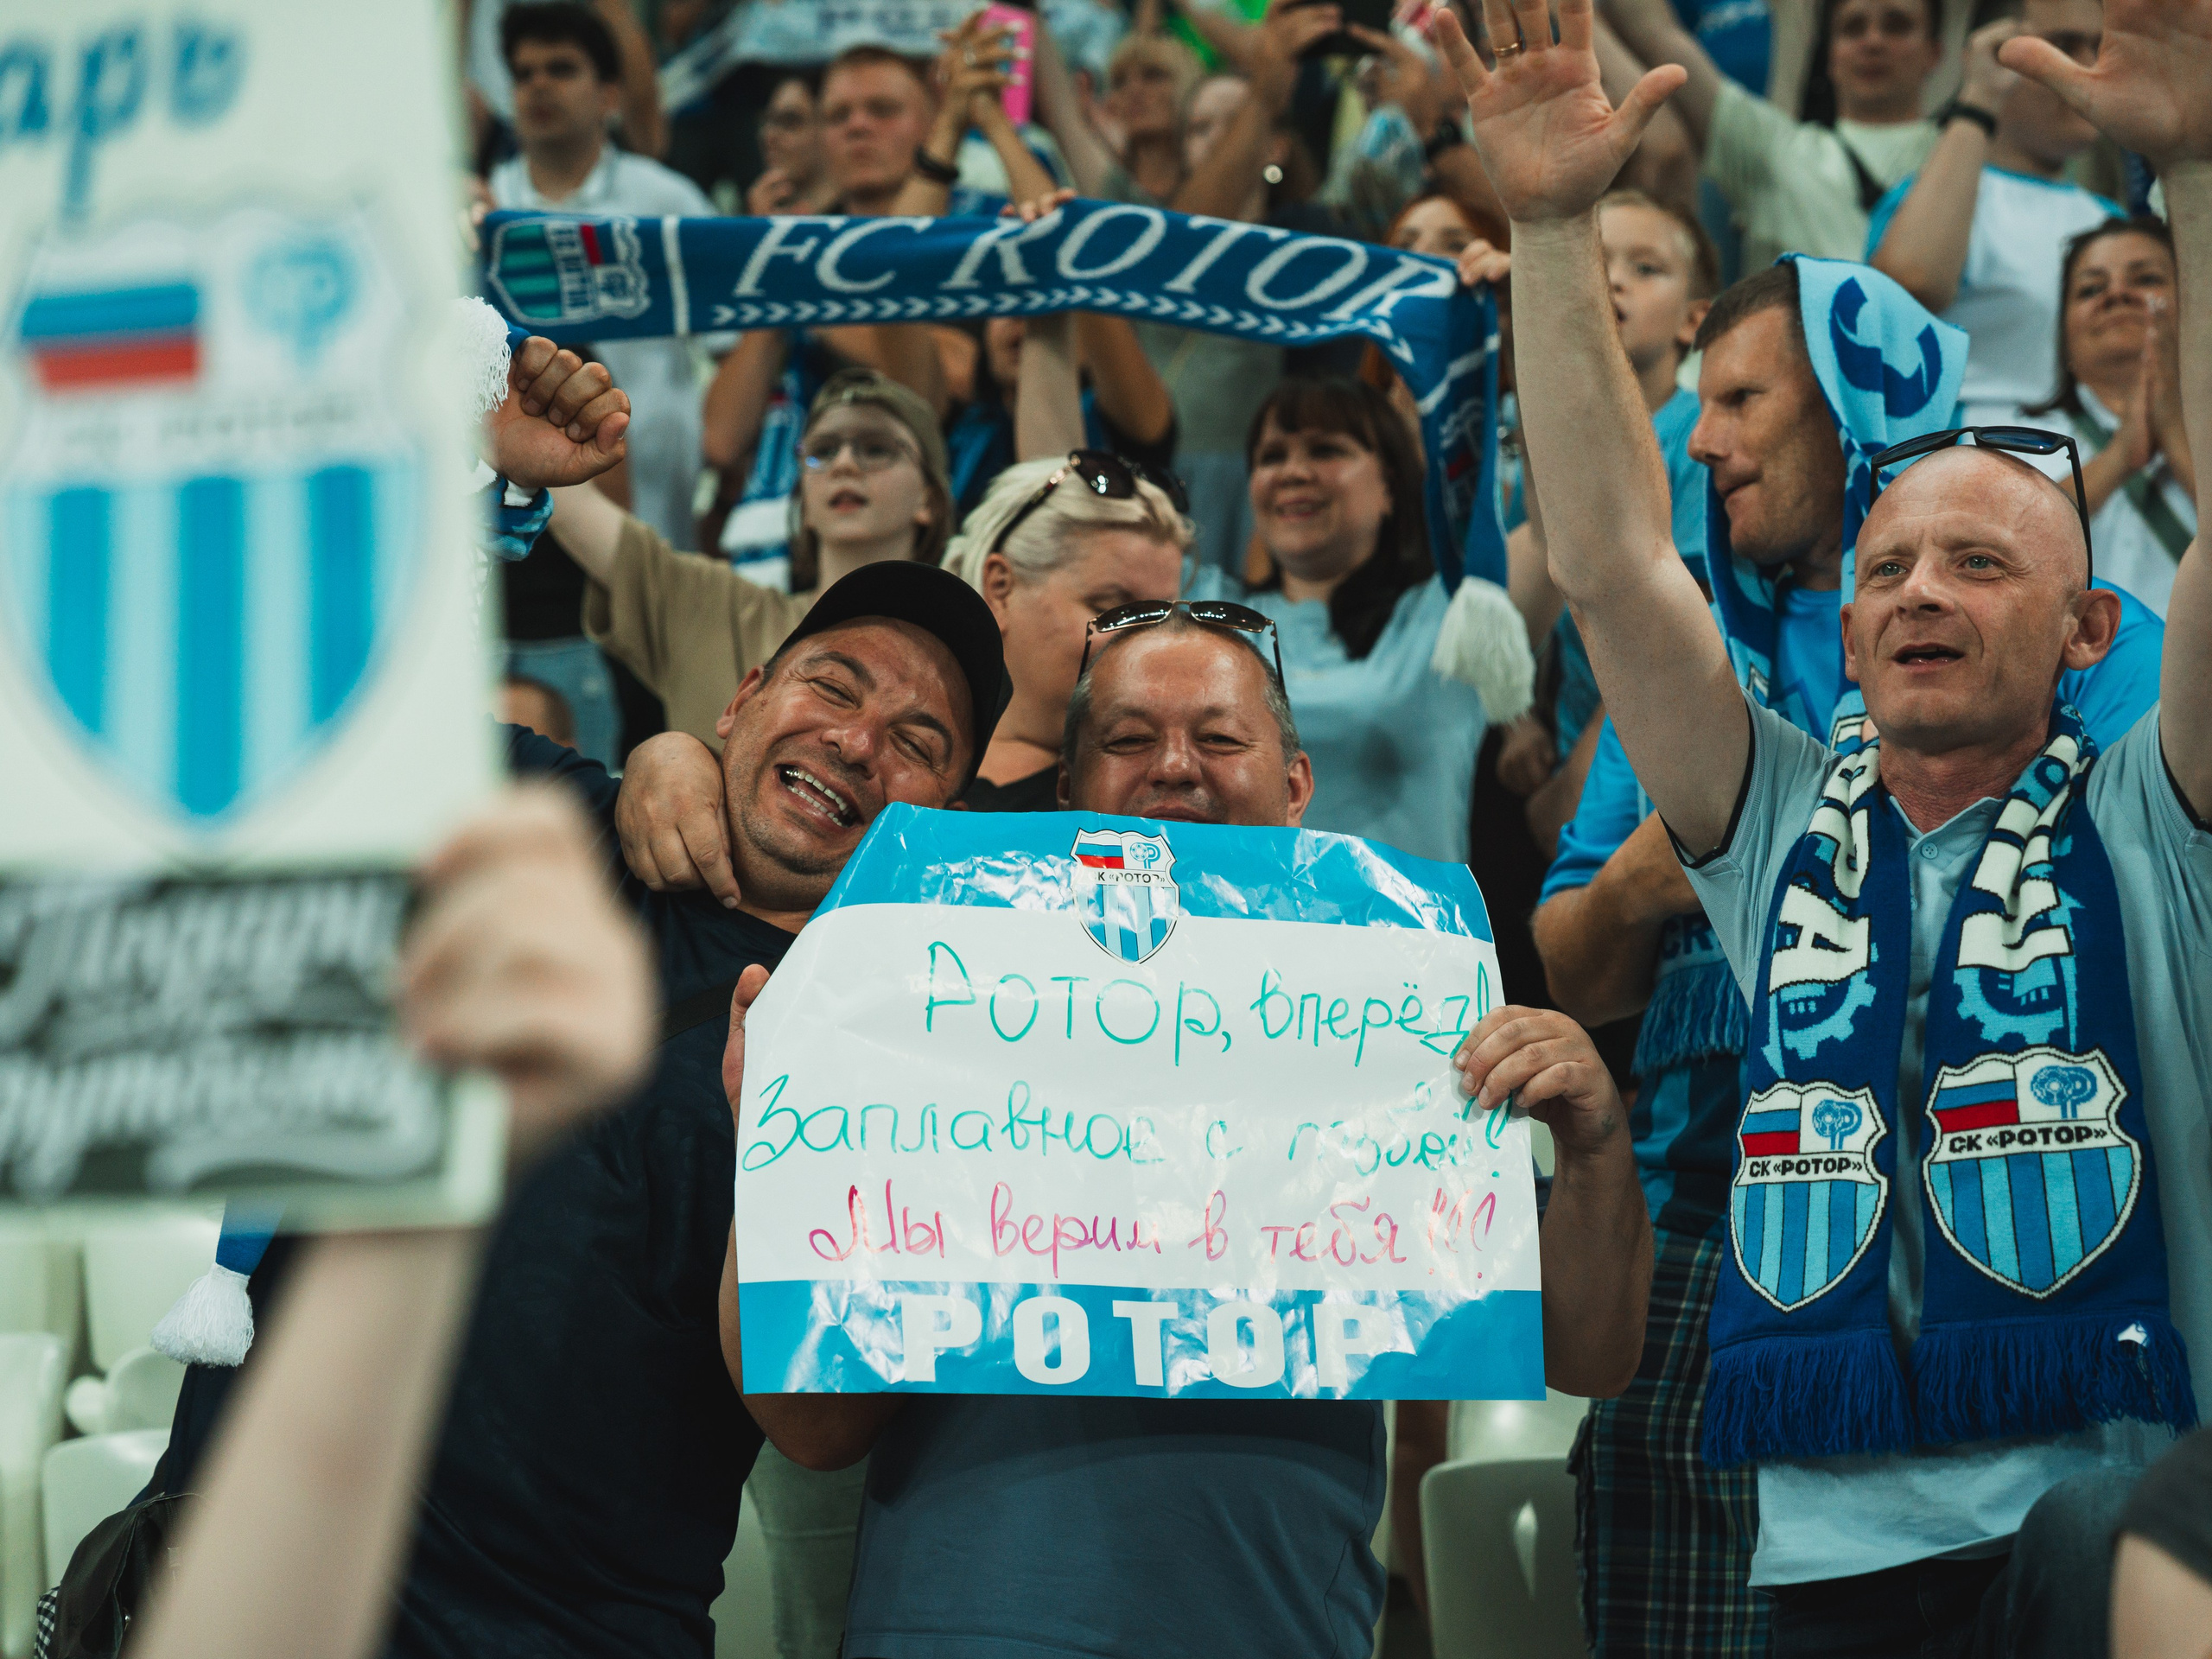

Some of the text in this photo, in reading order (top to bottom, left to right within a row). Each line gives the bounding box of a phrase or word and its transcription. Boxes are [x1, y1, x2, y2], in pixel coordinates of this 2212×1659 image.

[732, 204, 1459, 323] FC ROTOR
[1249, 961, 1489, 1067] вперёд!
[1749, 1157, 1862, 1177] СК «РОТОР»
[1949, 1125, 2107, 1154] СК «РОТОР»
[809, 1179, 945, 1262] Мы
[990, 1181, 1161, 1279] верим
[1188, 1190, 1229, 1262] в
[901, 1296, 1389, 1388] РОТОР
